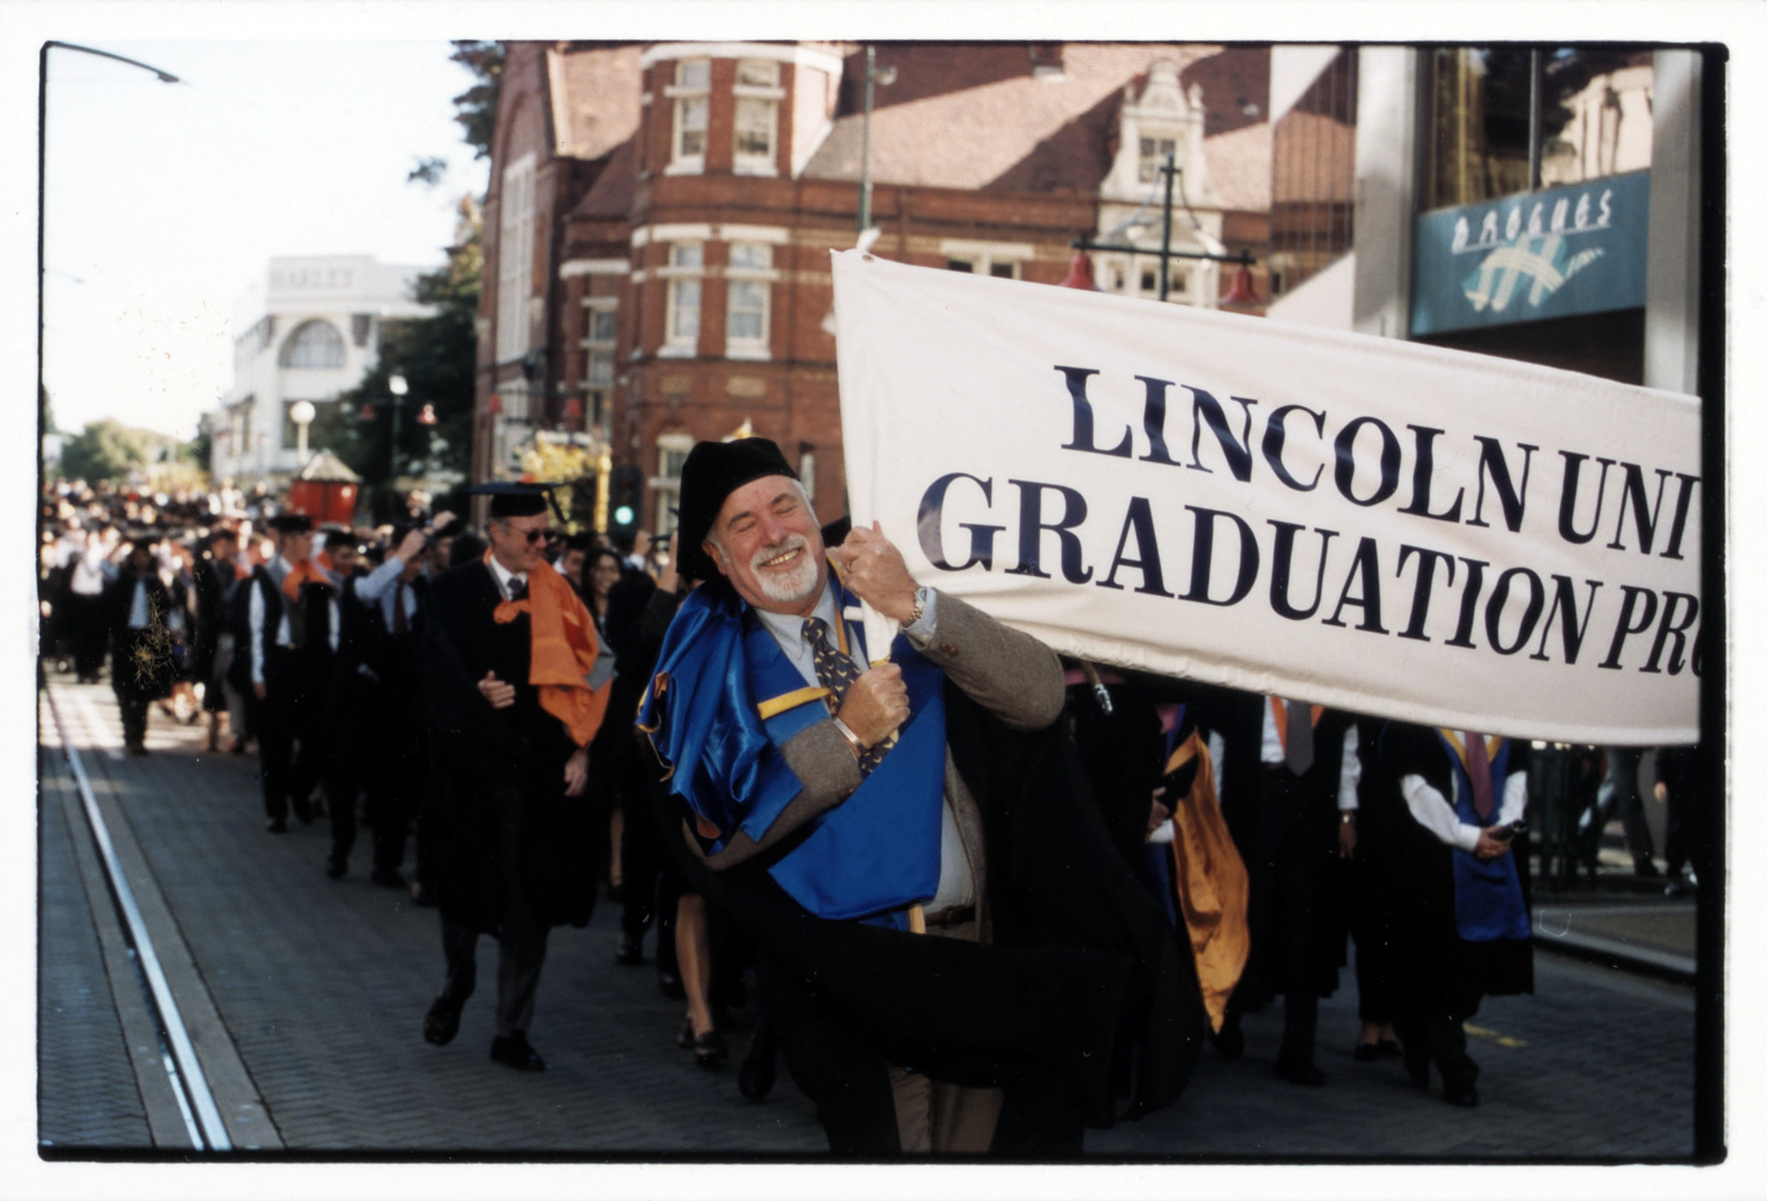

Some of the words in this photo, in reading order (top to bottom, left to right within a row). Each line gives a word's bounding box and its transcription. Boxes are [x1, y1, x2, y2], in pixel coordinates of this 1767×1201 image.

[1053, 365, 1540, 533] LINCOLN
[1557, 449, 1701, 560] UNI
[916, 472, 1604, 665] GRADUATION
[1598, 584, 1702, 678] PR
